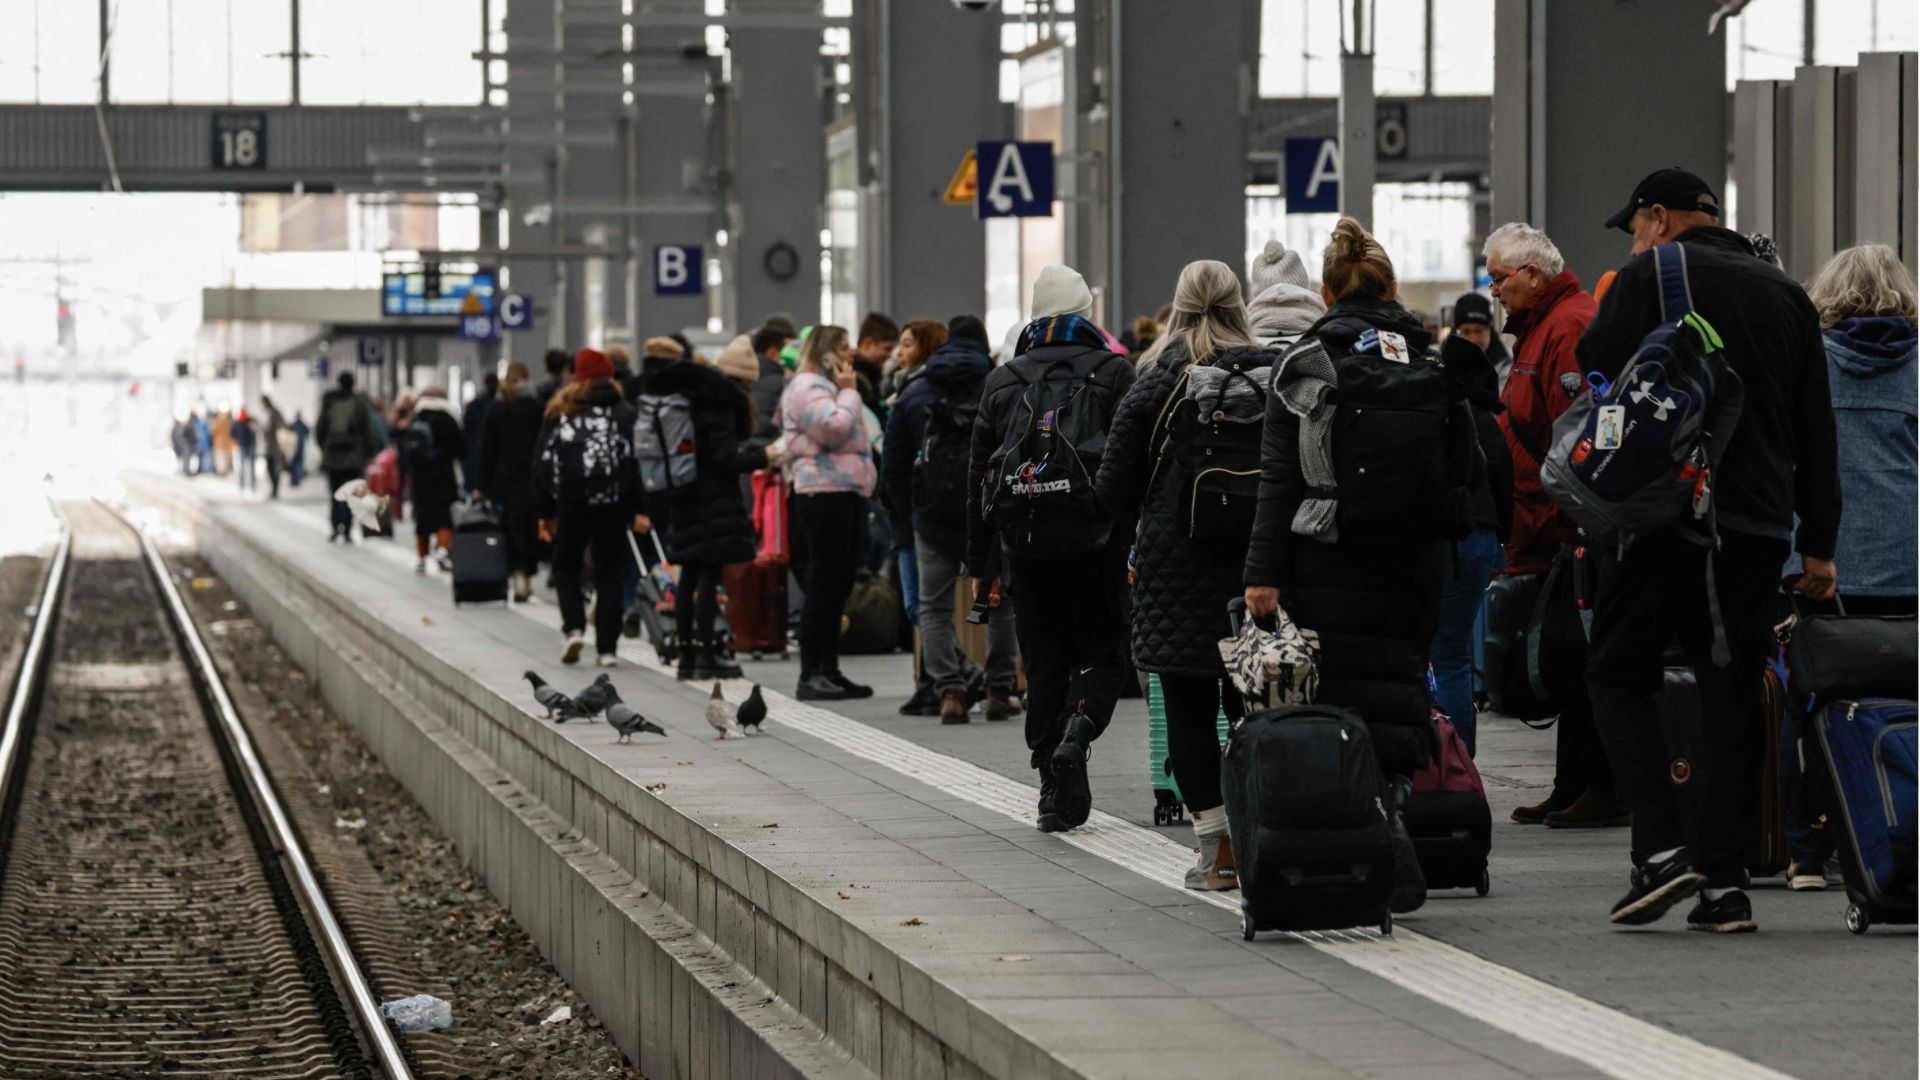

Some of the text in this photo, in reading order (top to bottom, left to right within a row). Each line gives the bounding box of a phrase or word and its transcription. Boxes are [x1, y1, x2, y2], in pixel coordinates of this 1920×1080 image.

[221, 130, 258, 166] 18
[1379, 119, 1406, 156] 0
[987, 143, 1035, 202] A
[1305, 139, 1341, 198] A
[659, 246, 688, 286] B
[501, 294, 525, 326] C
